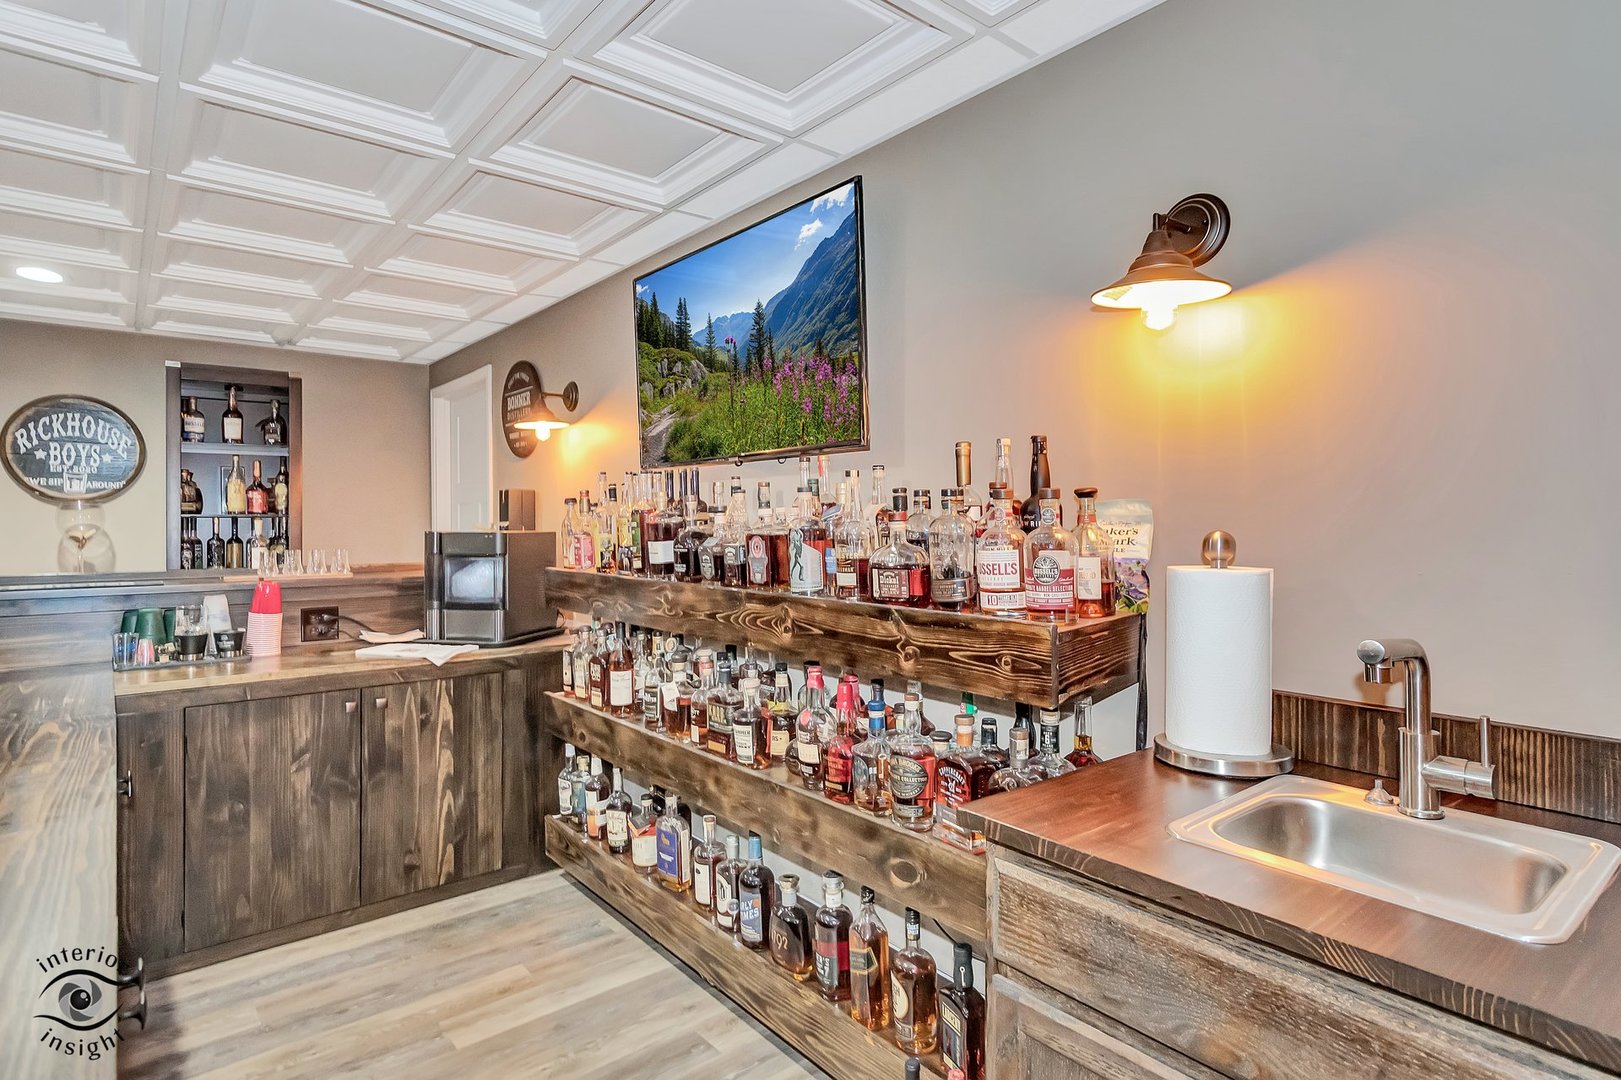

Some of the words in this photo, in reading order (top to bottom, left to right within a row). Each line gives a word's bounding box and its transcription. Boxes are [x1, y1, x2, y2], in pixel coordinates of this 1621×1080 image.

[15, 412, 131, 459] RICKHOUSE
[49, 441, 101, 468] BOYS
[1106, 527, 1139, 536] ker's
[980, 562, 1018, 576] SSELL'S
[741, 900, 753, 911] RLY
[743, 908, 760, 921] MES
